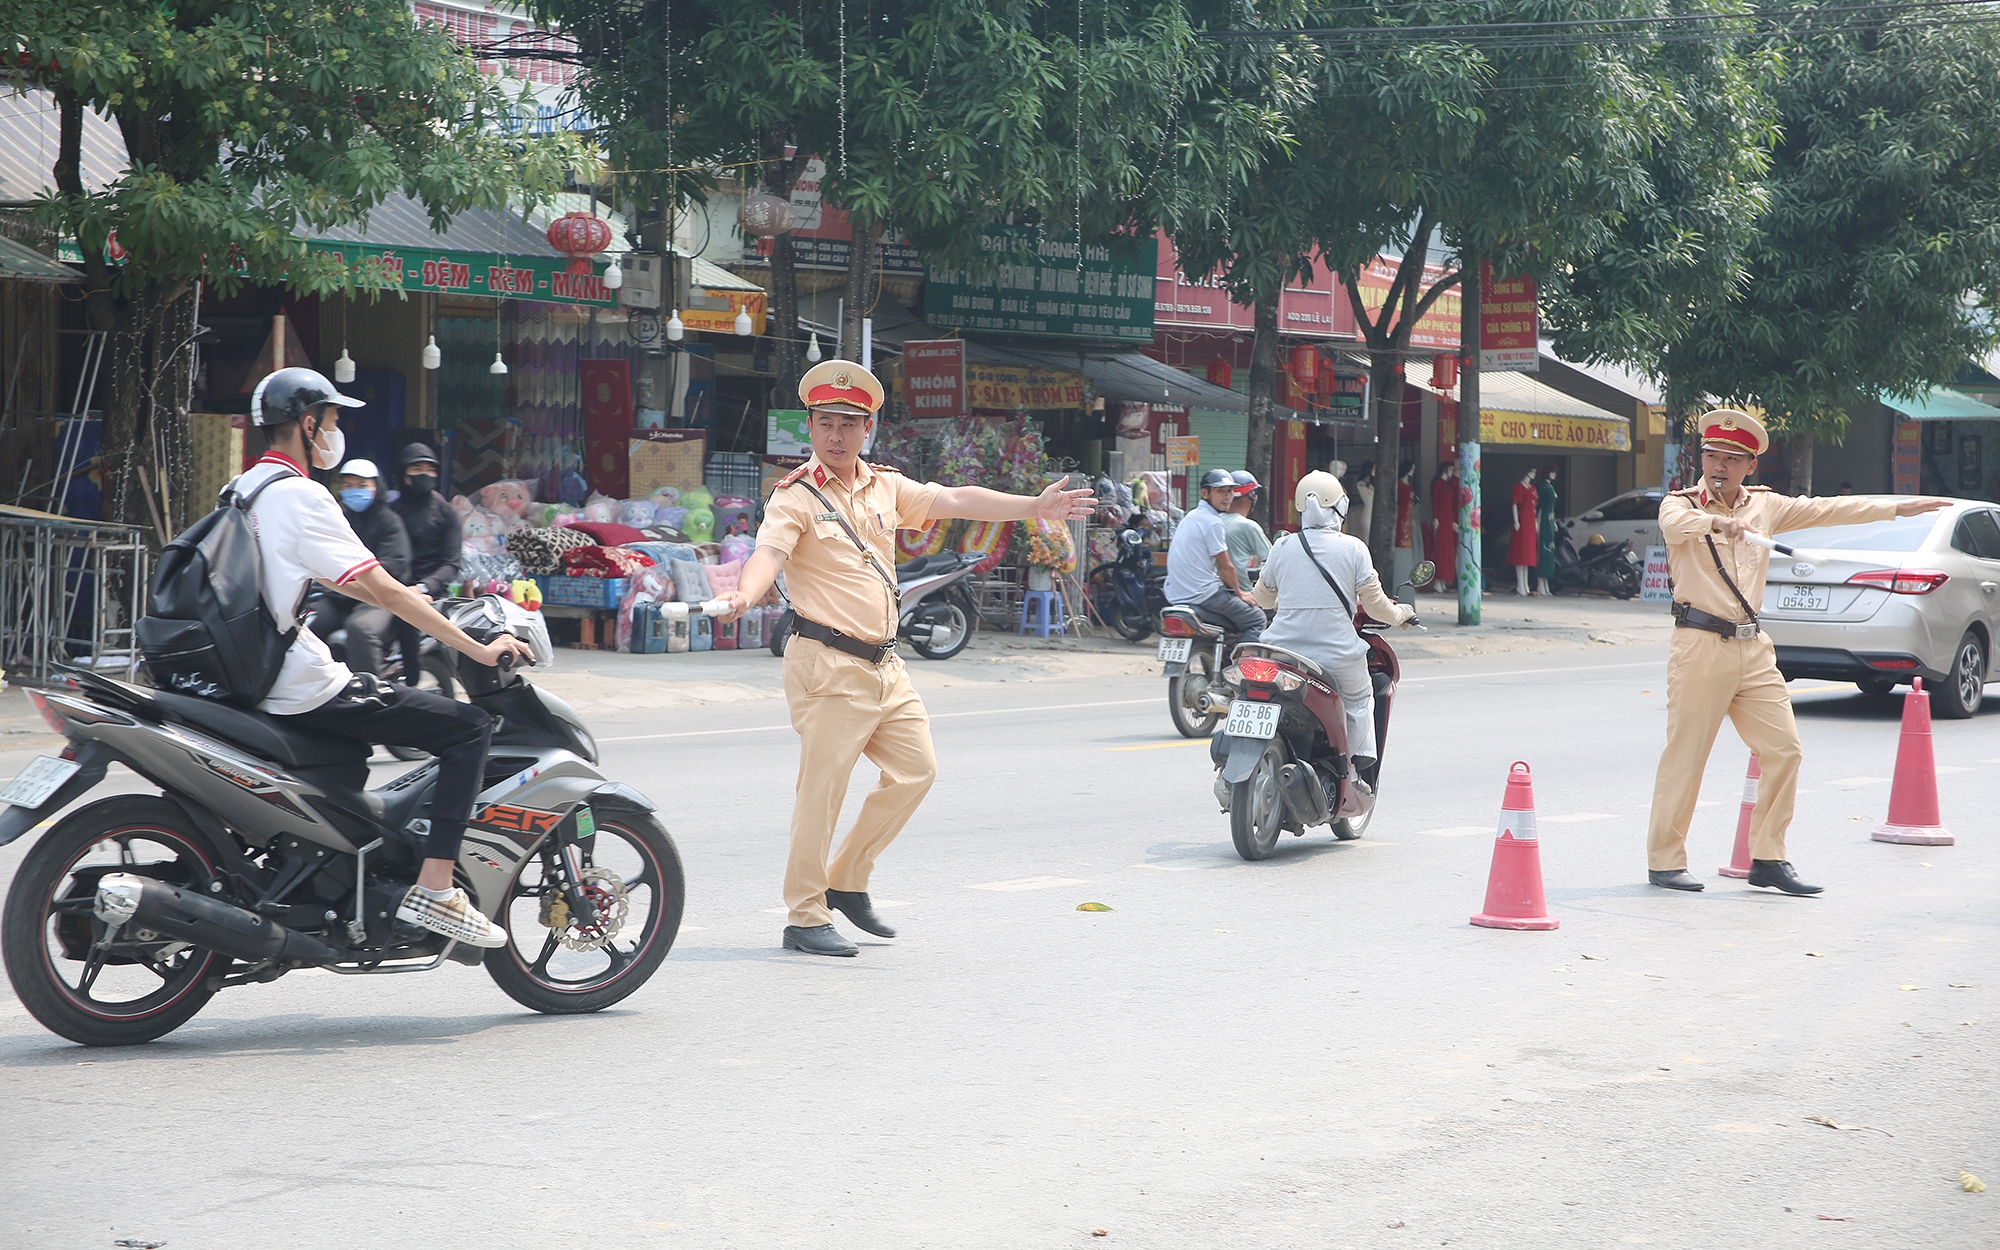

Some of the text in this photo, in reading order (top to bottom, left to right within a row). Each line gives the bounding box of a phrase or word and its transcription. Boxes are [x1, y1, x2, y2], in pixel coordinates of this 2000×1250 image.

[423, 257, 471, 293] ĐỆM
[952, 293, 970, 309] BÁN
[971, 294, 994, 311] BUÔN
[1000, 296, 1018, 312] BÁN
[1036, 299, 1059, 318] NHẬN
[1060, 300, 1075, 319] ĐẶT
[1078, 303, 1097, 318] THEO
[1098, 303, 1113, 319] YÊU
[1114, 302, 1131, 320] CẦU
[1482, 303, 1502, 314] TRONG
[1513, 299, 1535, 316] NGHIỆP
[1312, 310, 1320, 323] LÊ
[1486, 318, 1531, 333] CỦA CHÚNG TA
[910, 373, 958, 390] NHÔM
[915, 392, 953, 409] KÍNH
[983, 380, 1009, 405] SẮT
[1020, 381, 1062, 406] NHÔM
[1500, 421, 1527, 439] CHO
[1530, 419, 1563, 442] THUÊ
[1566, 420, 1584, 443] ÁO
[1587, 422, 1610, 445] DÀI
[1645, 575, 1662, 589] CÁC
[1793, 586, 1814, 597] 36K
[1783, 597, 1822, 608] 054.97
[1236, 704, 1273, 720] 36-B6
[1228, 719, 1274, 736] 606.10
